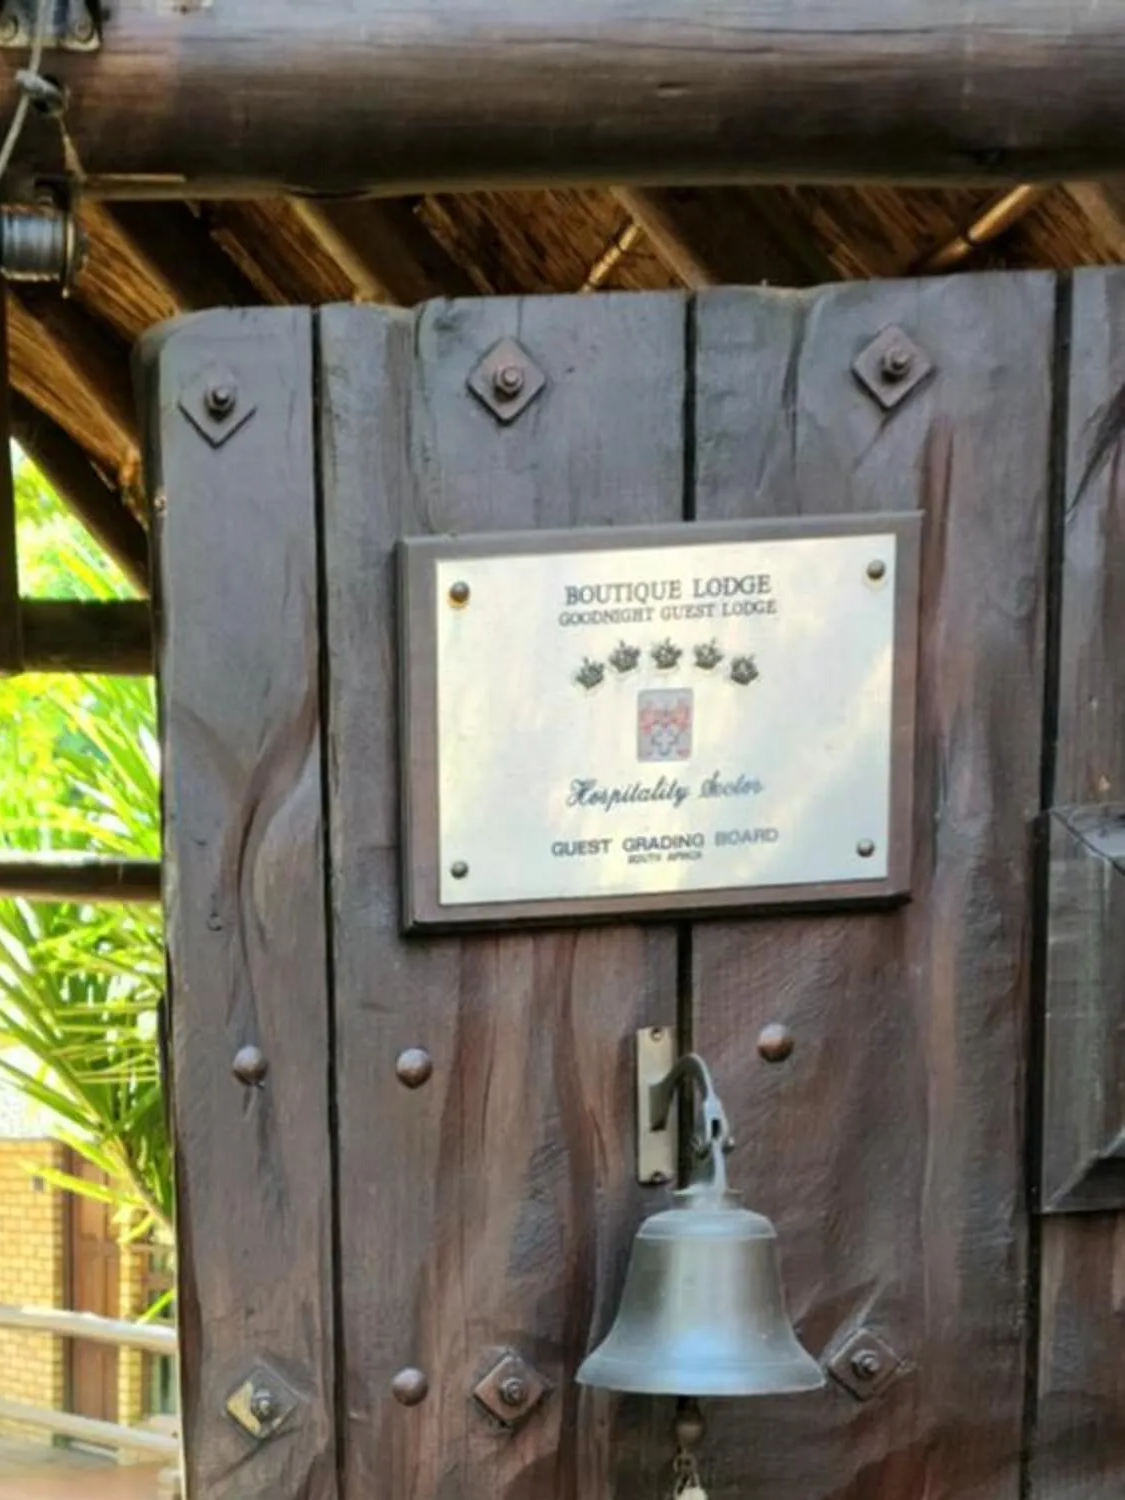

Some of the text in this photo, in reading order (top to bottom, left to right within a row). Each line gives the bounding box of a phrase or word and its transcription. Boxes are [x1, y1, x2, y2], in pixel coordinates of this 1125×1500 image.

[564, 574, 771, 606] BOUTIQUE LODGE
[559, 600, 777, 627] GOODNIGHT GUEST LODGE
[566, 774, 690, 812] Hospitality
[551, 827, 779, 857] GUEST GRADING BOARD
